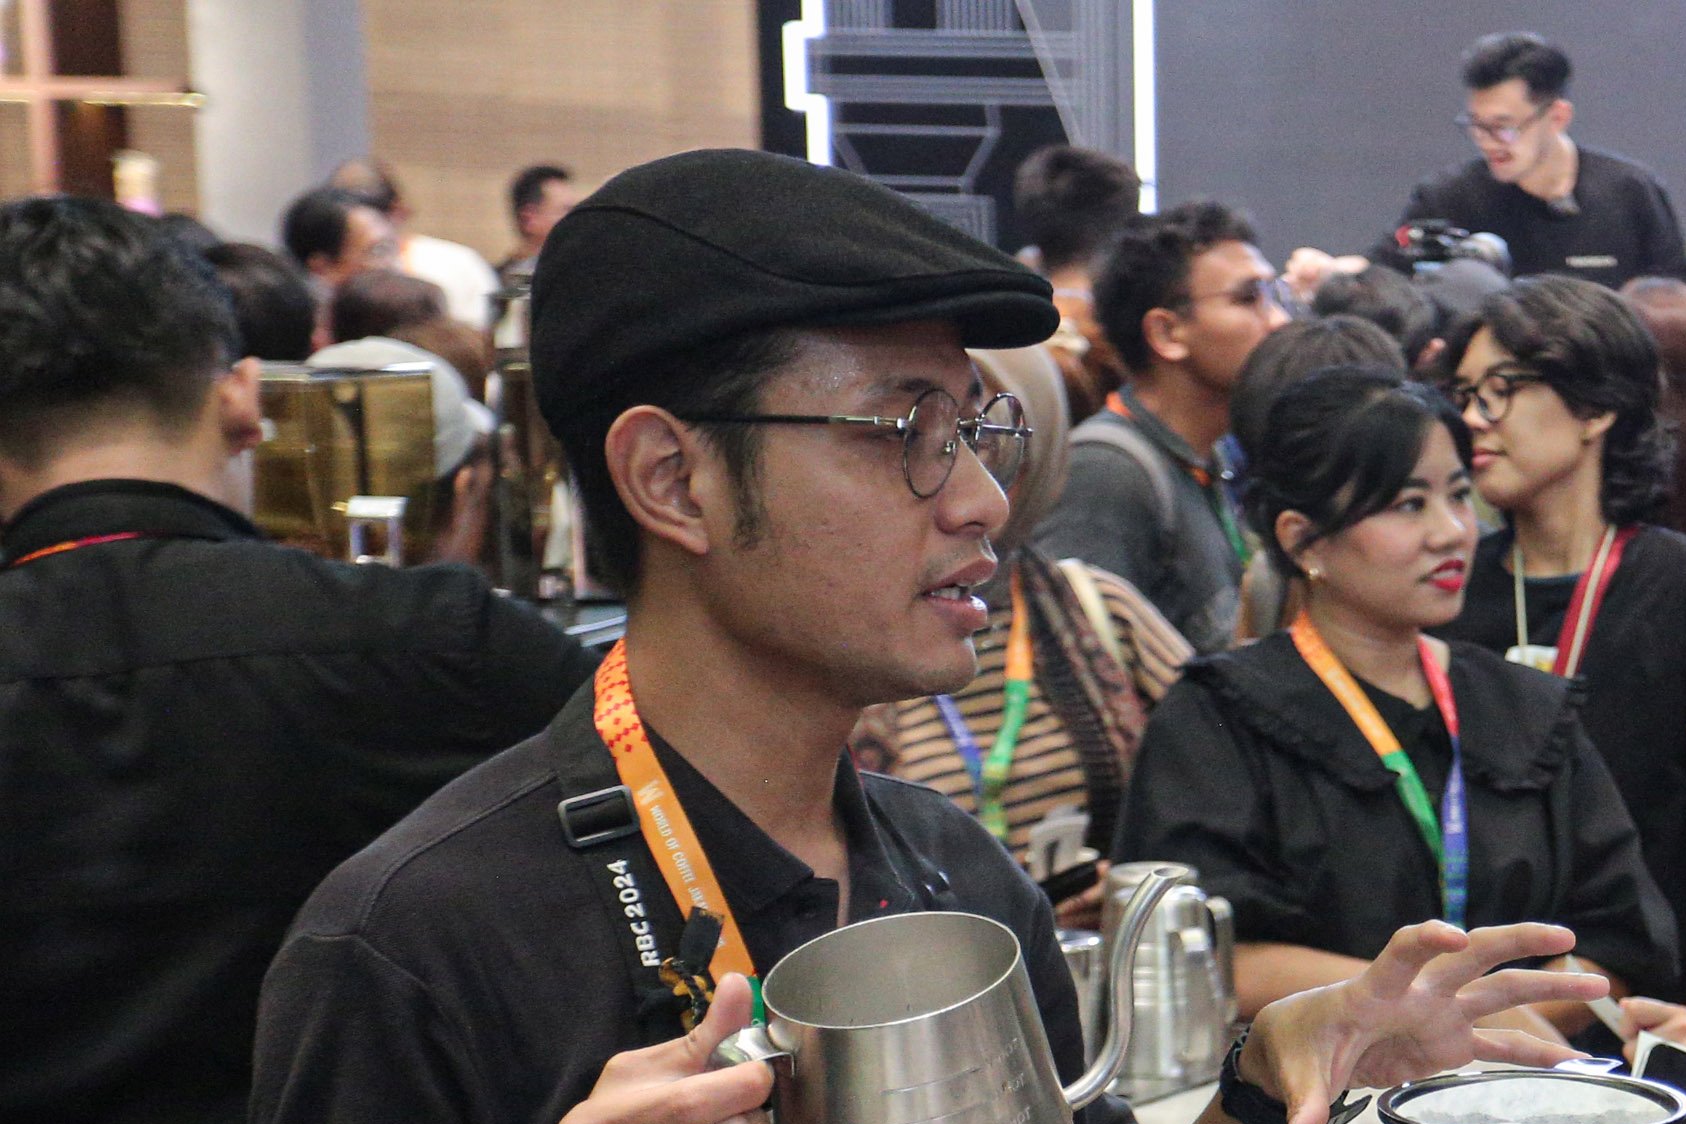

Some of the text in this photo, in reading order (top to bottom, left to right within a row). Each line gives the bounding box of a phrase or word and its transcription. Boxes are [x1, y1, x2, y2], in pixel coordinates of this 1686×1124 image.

[650, 805, 672, 838] WORLD
[666, 837, 681, 851] OF
[673, 851, 696, 885] COFFEE
[606, 858, 661, 968] RBC 2024
